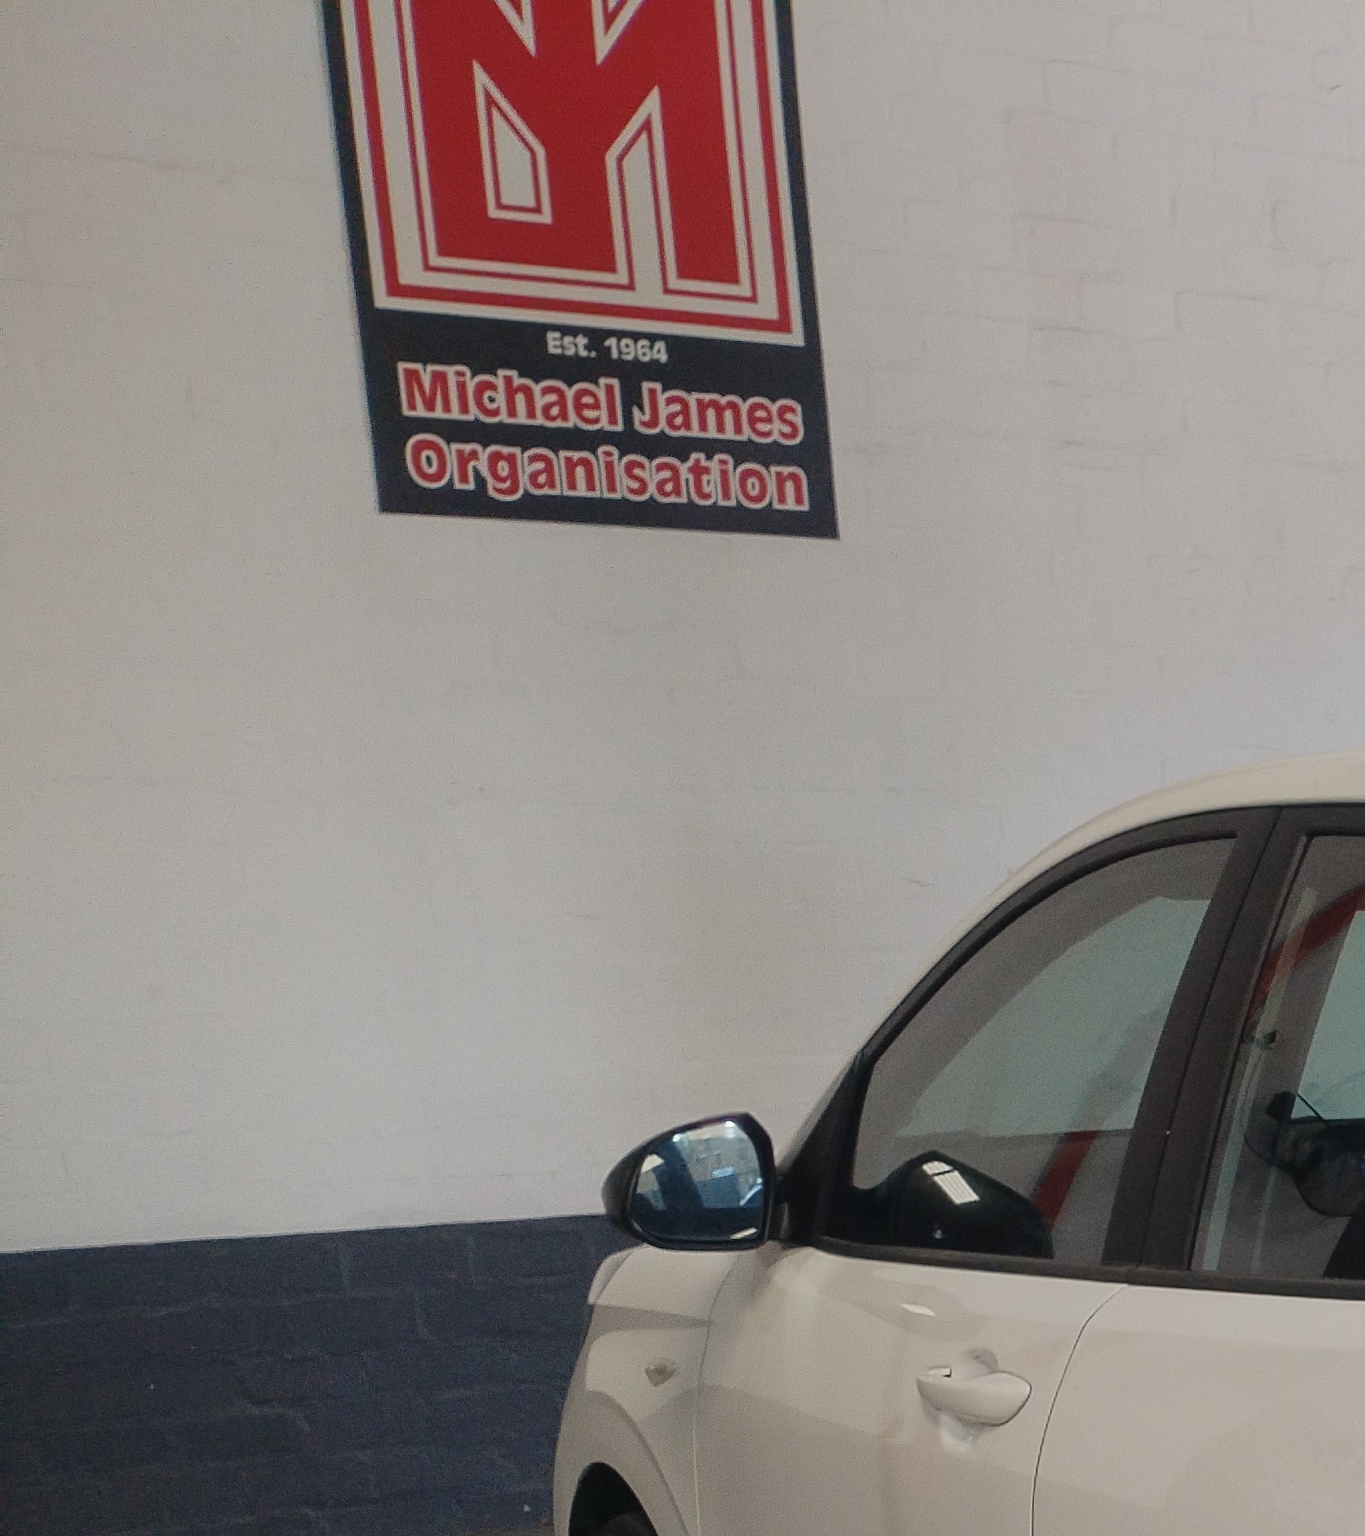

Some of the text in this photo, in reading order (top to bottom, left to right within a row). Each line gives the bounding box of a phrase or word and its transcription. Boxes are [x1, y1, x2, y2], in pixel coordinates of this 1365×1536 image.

[546, 330, 668, 363] Est. 1964
[397, 361, 805, 445] Michael James
[405, 432, 809, 511] Organisation
